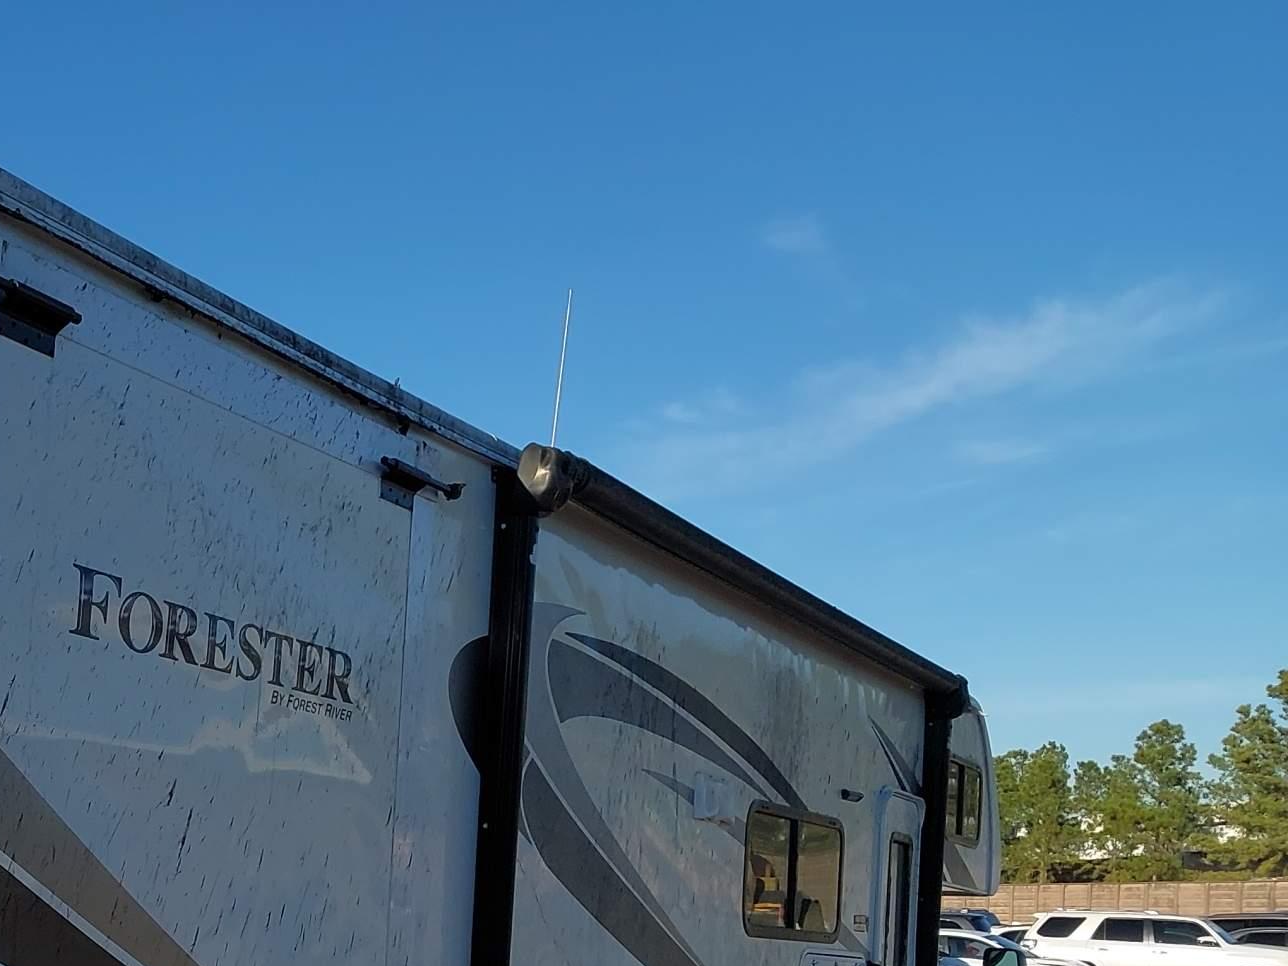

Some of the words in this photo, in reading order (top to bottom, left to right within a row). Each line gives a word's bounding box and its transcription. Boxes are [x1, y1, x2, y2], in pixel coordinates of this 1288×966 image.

[68, 563, 354, 704] FORESTER
[286, 694, 323, 716] FOREST
[324, 703, 353, 722] RIVER
